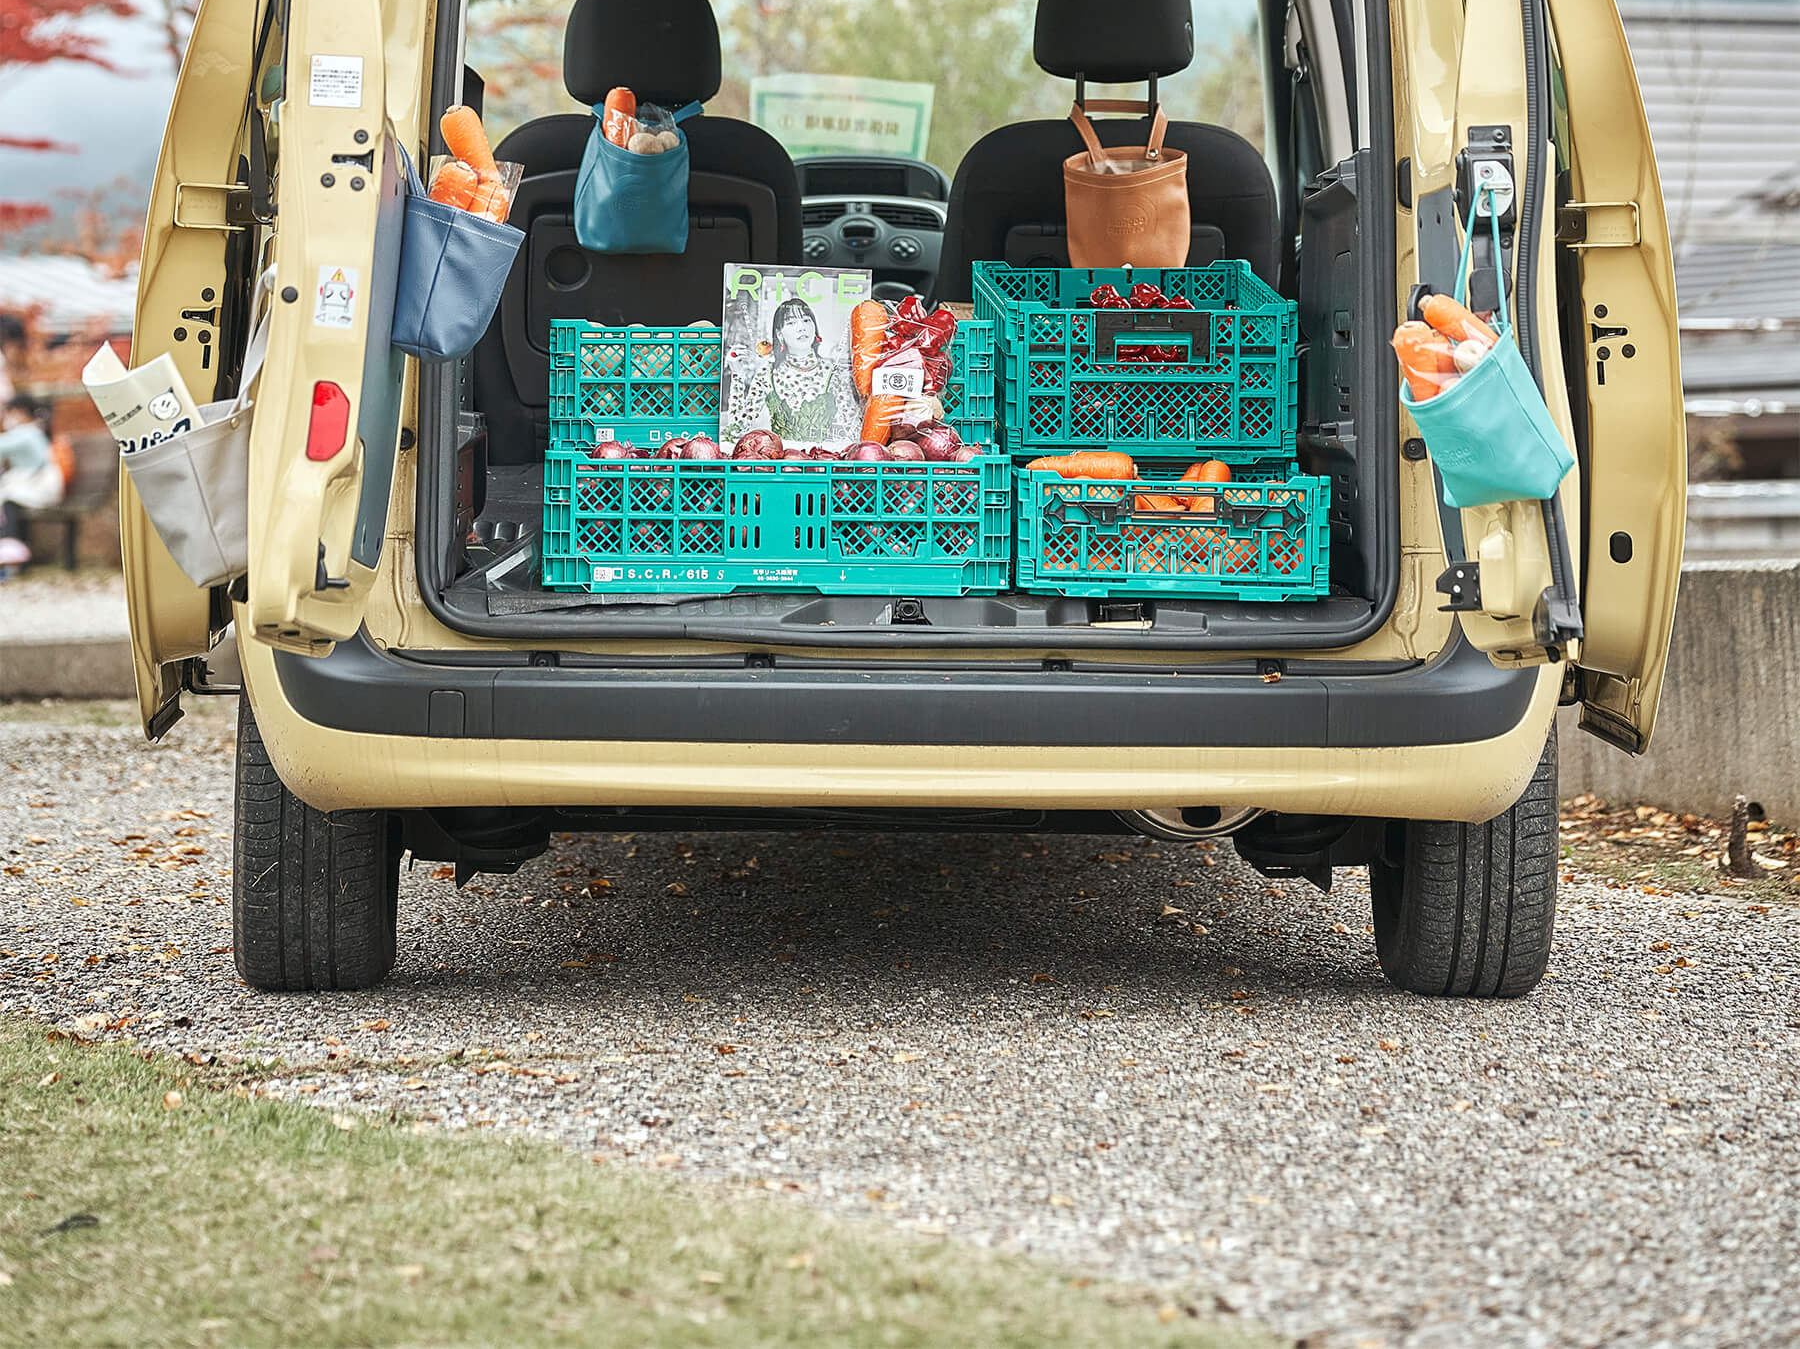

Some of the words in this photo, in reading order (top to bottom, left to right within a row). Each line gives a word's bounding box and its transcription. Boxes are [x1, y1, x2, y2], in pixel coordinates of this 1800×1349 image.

[730, 268, 867, 304] RiCE
[664, 431, 712, 441] SCR.
[686, 569, 709, 579] 615
